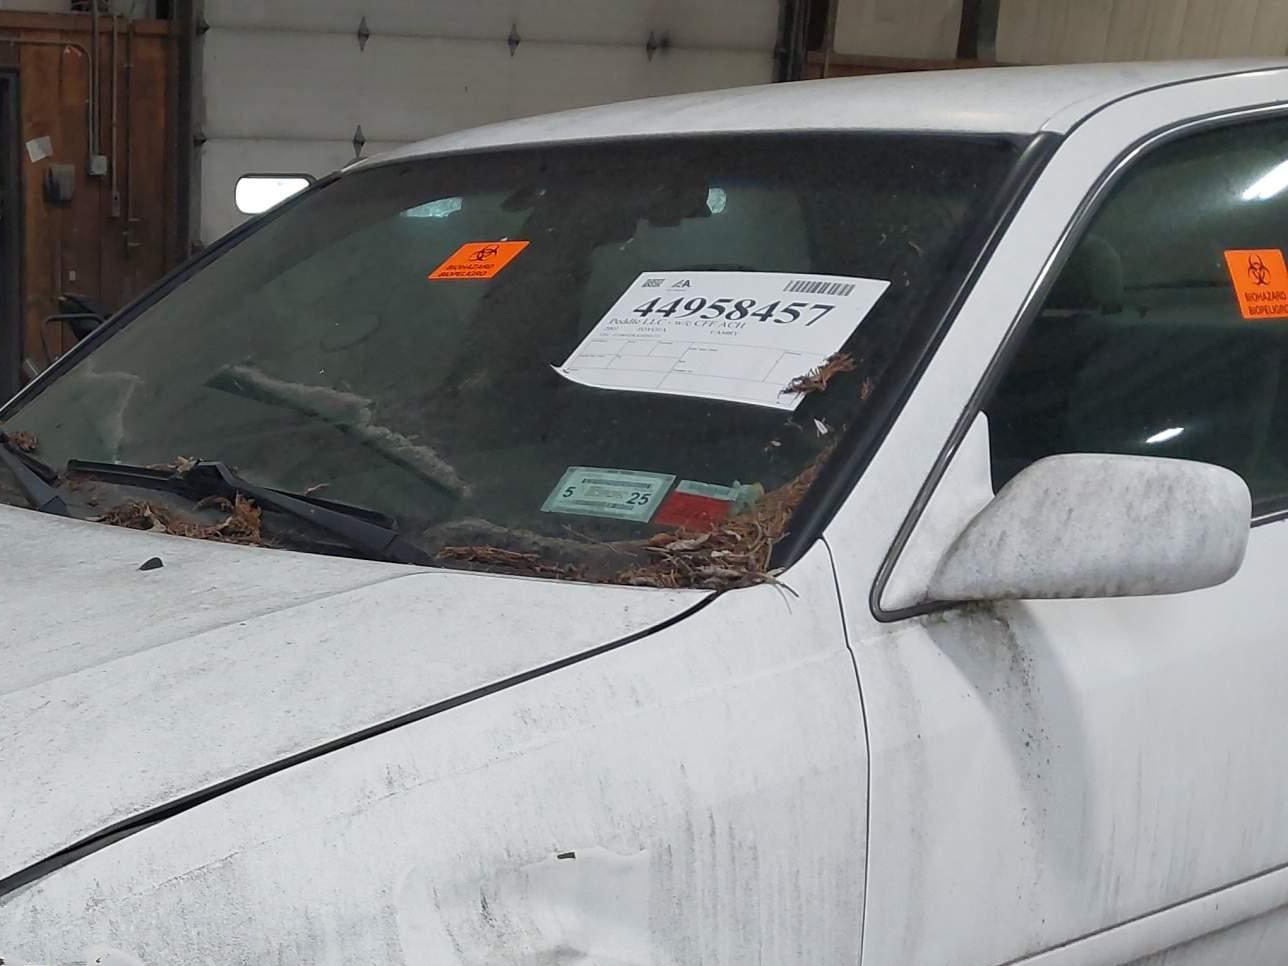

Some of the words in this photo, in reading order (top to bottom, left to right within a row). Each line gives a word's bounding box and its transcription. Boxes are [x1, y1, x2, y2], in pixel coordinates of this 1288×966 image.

[1244, 291, 1287, 302] BIOHAZARD
[633, 297, 836, 327] 44958457
[562, 486, 576, 498] 5
[626, 492, 651, 506] 25
